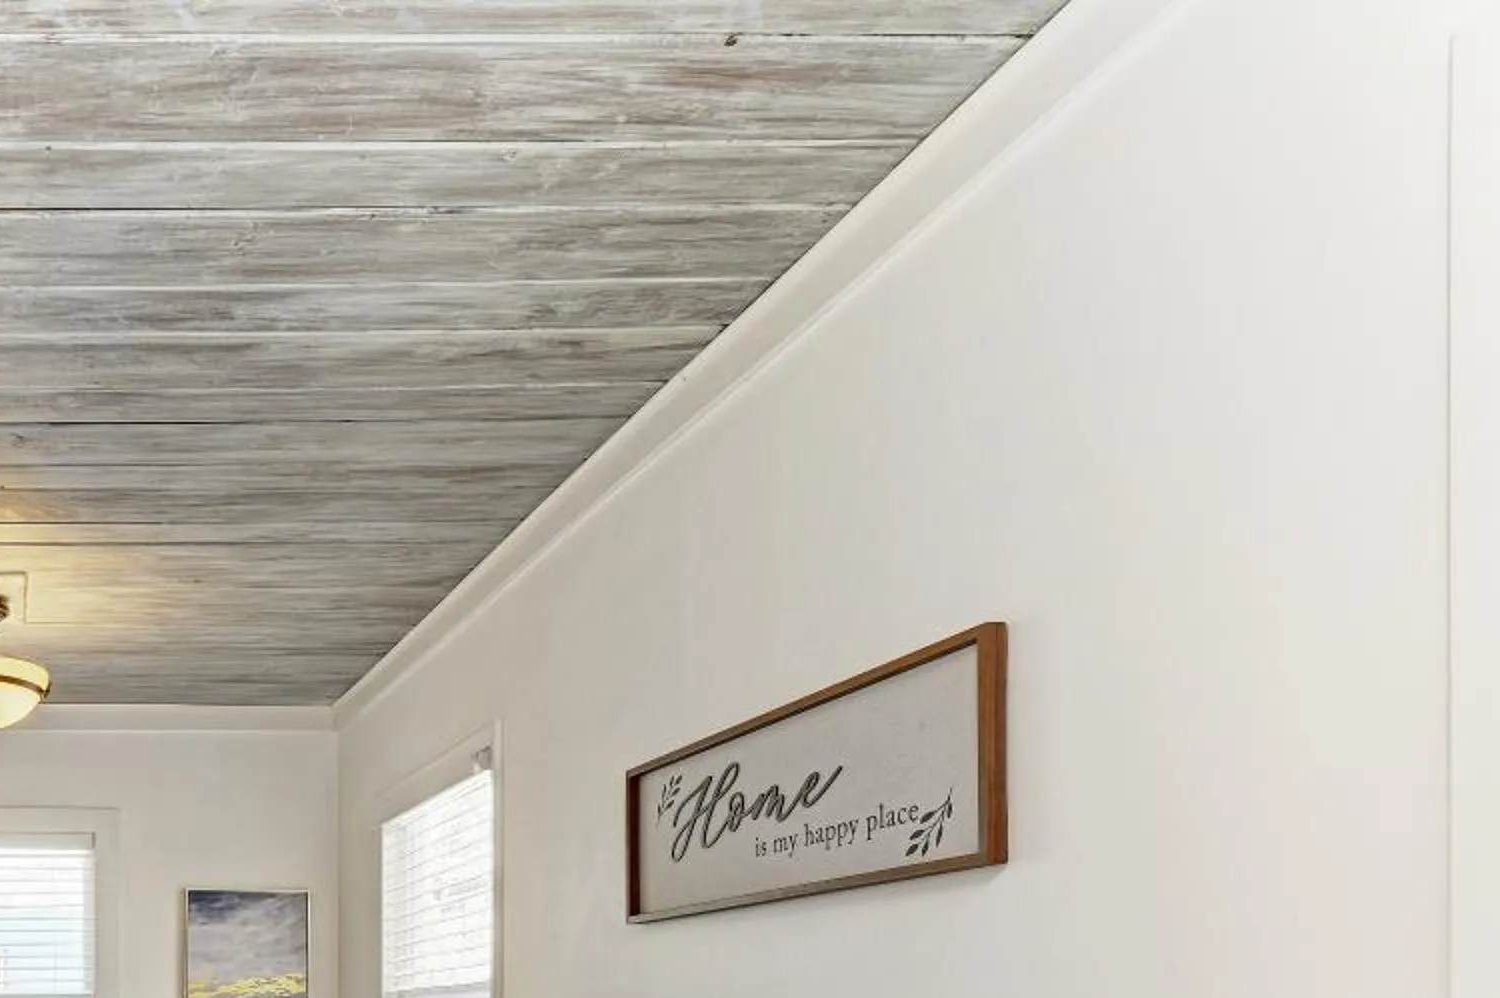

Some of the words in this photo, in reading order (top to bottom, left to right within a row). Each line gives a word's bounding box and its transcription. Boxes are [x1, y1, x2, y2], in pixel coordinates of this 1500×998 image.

[671, 761, 843, 863] Home
[755, 837, 767, 857] is
[773, 832, 800, 857] my
[803, 818, 859, 850] happy
[866, 803, 920, 842] place
